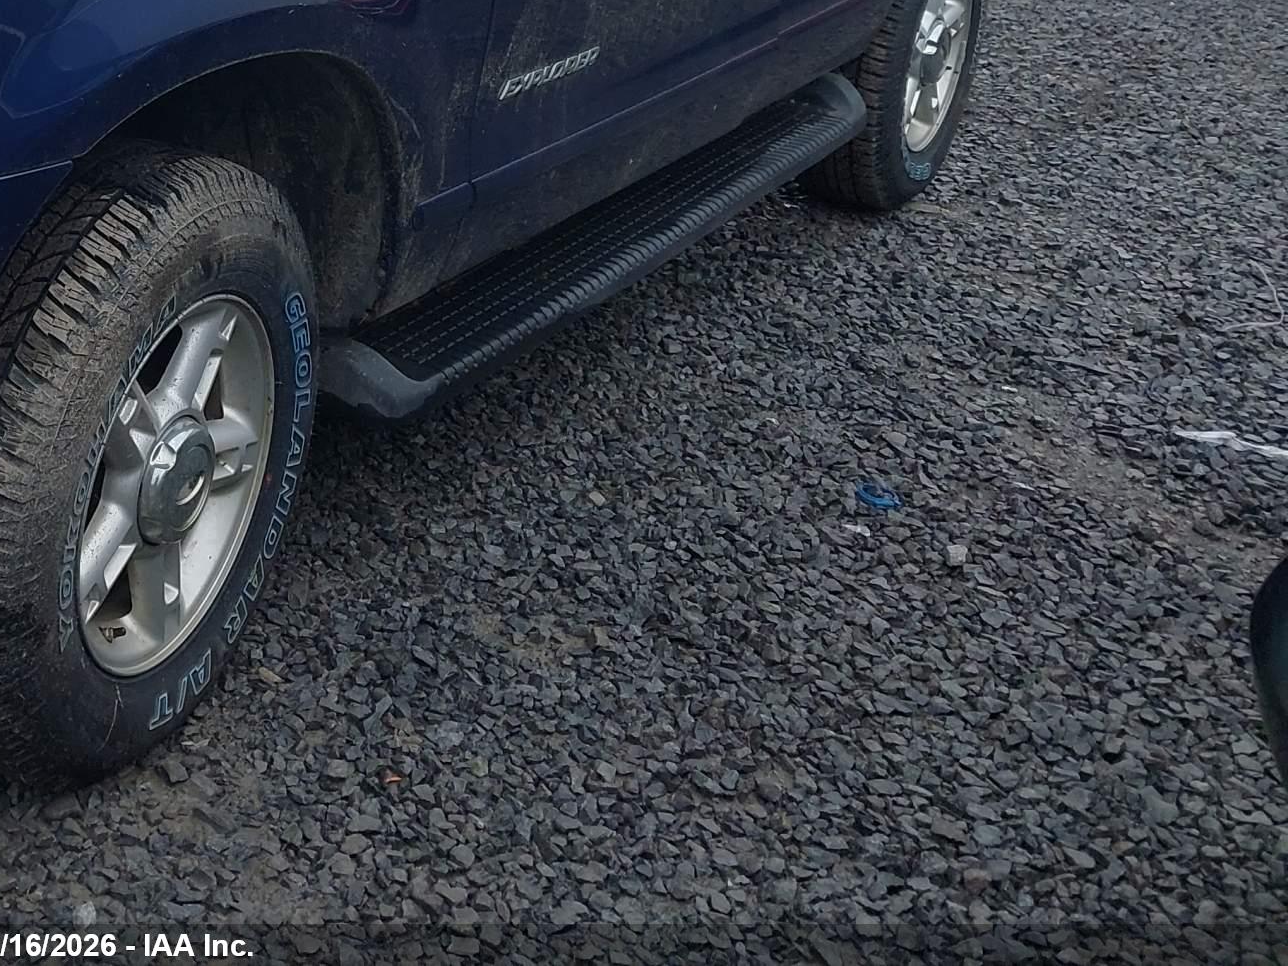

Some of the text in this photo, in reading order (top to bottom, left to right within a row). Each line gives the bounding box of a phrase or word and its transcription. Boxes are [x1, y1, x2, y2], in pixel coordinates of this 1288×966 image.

[497, 45, 600, 101] EXPLORER
[149, 292, 312, 730] GEOLANDAR A/T
